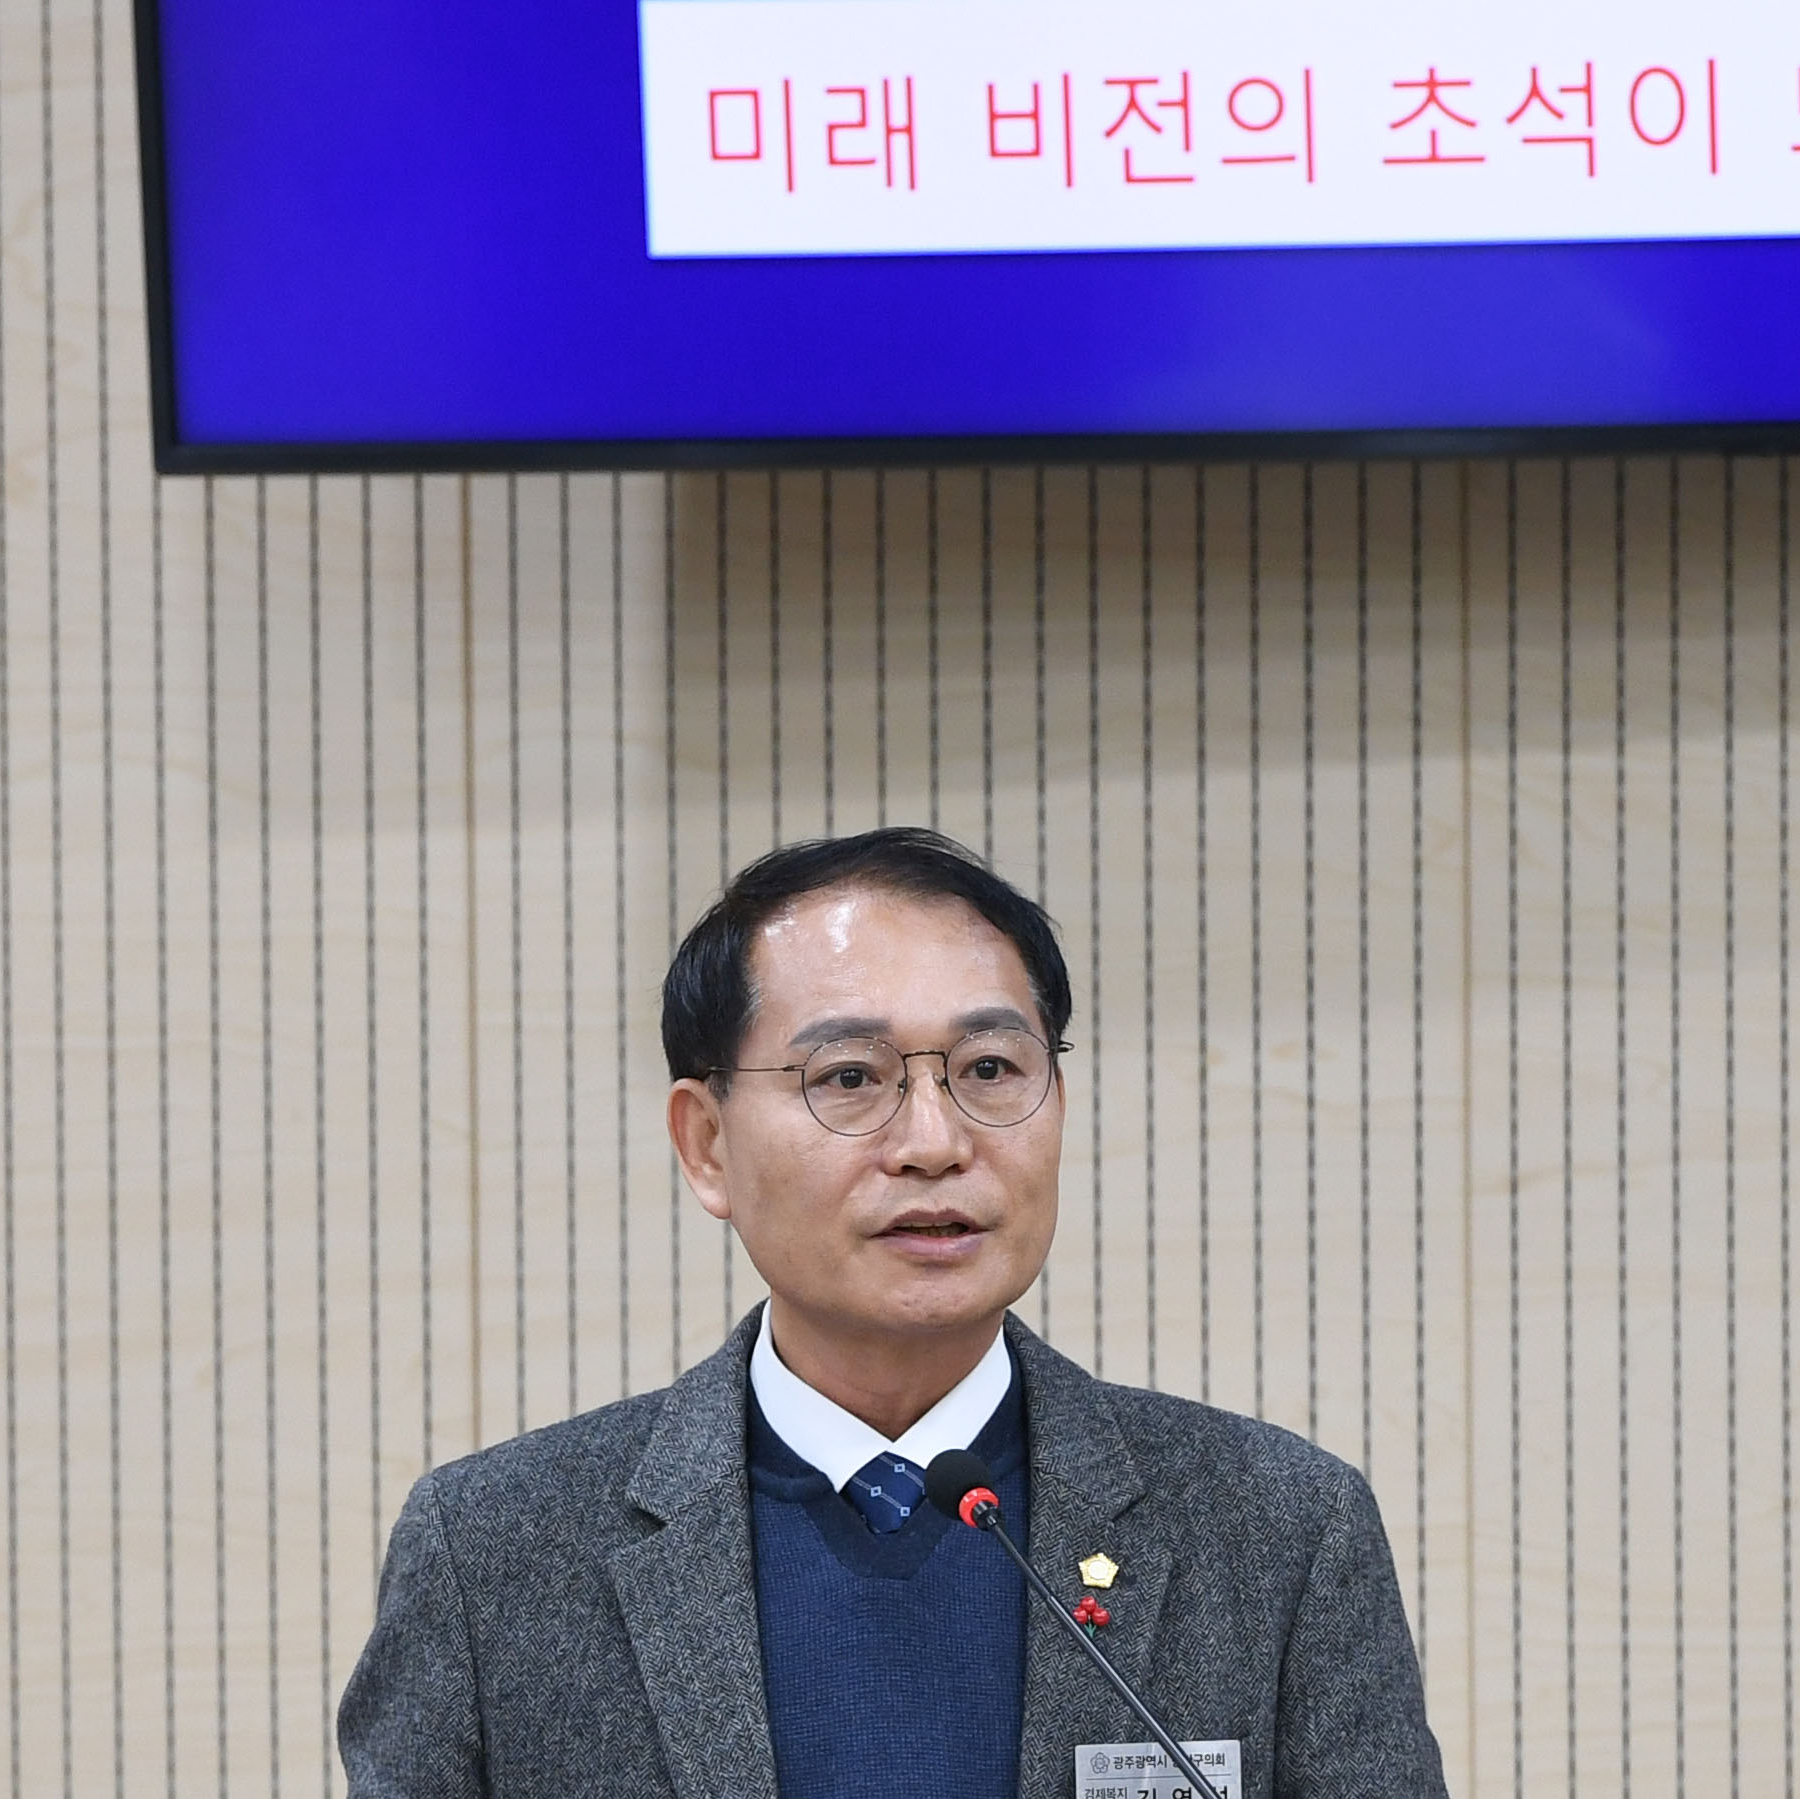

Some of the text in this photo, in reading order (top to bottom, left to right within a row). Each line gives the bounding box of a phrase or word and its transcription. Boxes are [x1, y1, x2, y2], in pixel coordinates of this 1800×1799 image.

[706, 74, 919, 195] 미래
[985, 66, 1318, 190] 비전의
[1381, 56, 1721, 180] 초석이
[1113, 1753, 1226, 1769] 광주광역시 구의회
